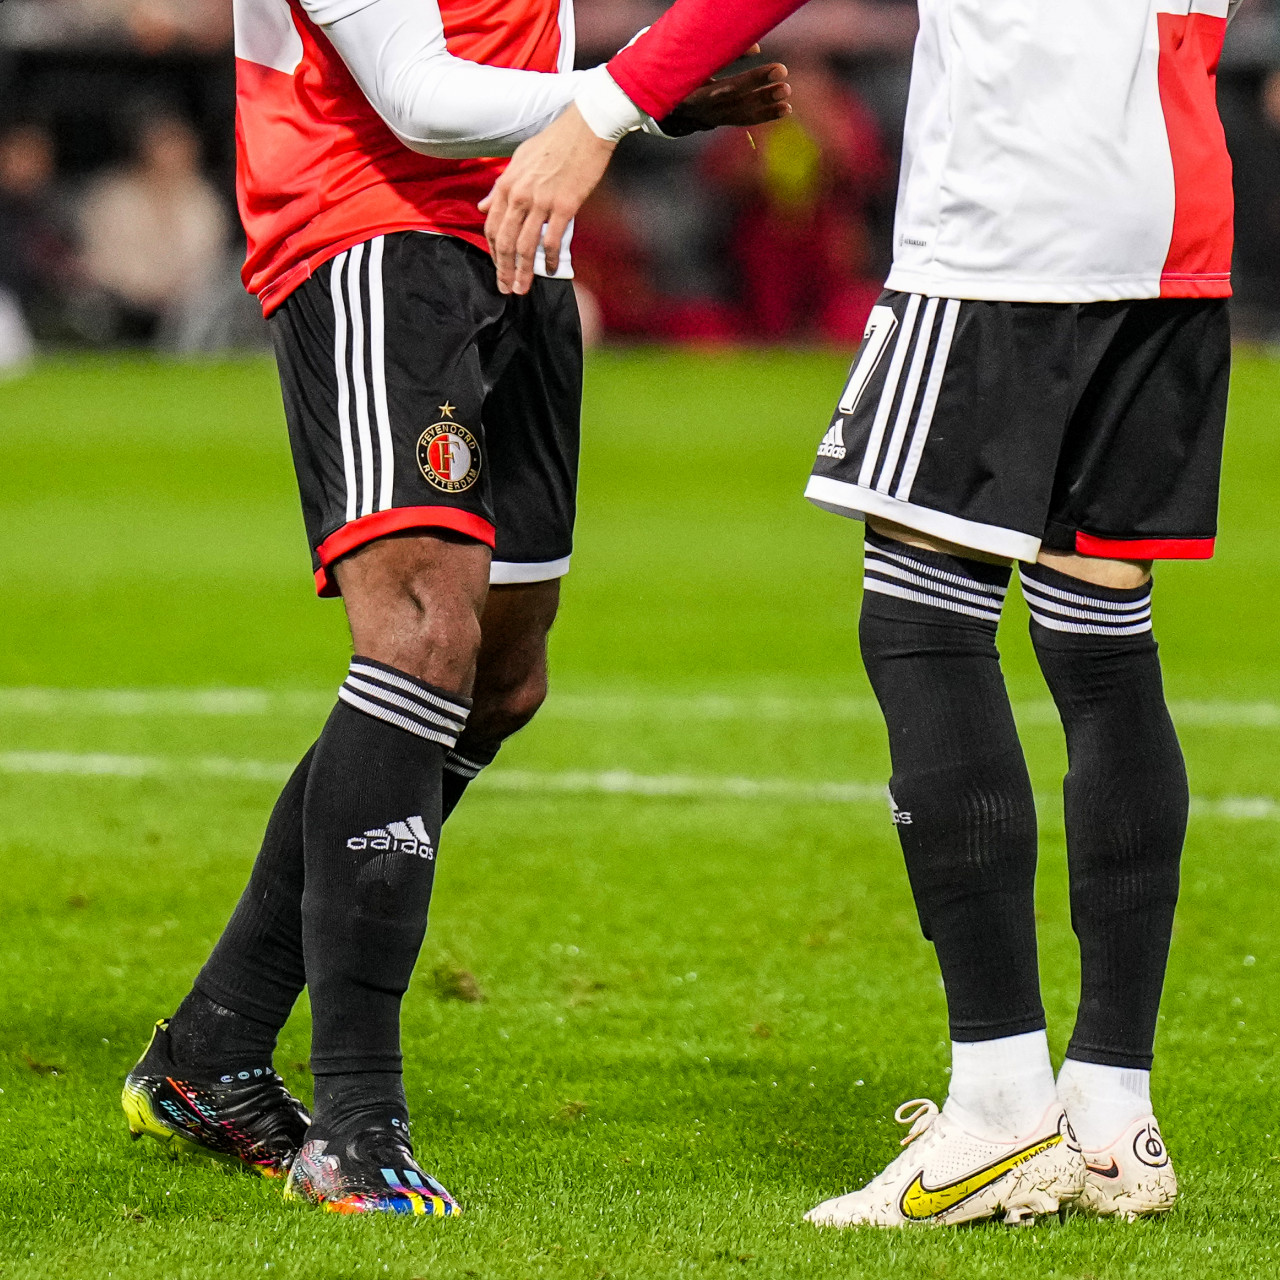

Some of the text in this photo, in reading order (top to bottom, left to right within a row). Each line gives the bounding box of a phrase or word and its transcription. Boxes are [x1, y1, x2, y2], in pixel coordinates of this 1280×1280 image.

[421, 424, 476, 449] FEYENOORD
[423, 464, 477, 490] ROTTERDAM
[347, 836, 434, 860] adidas
